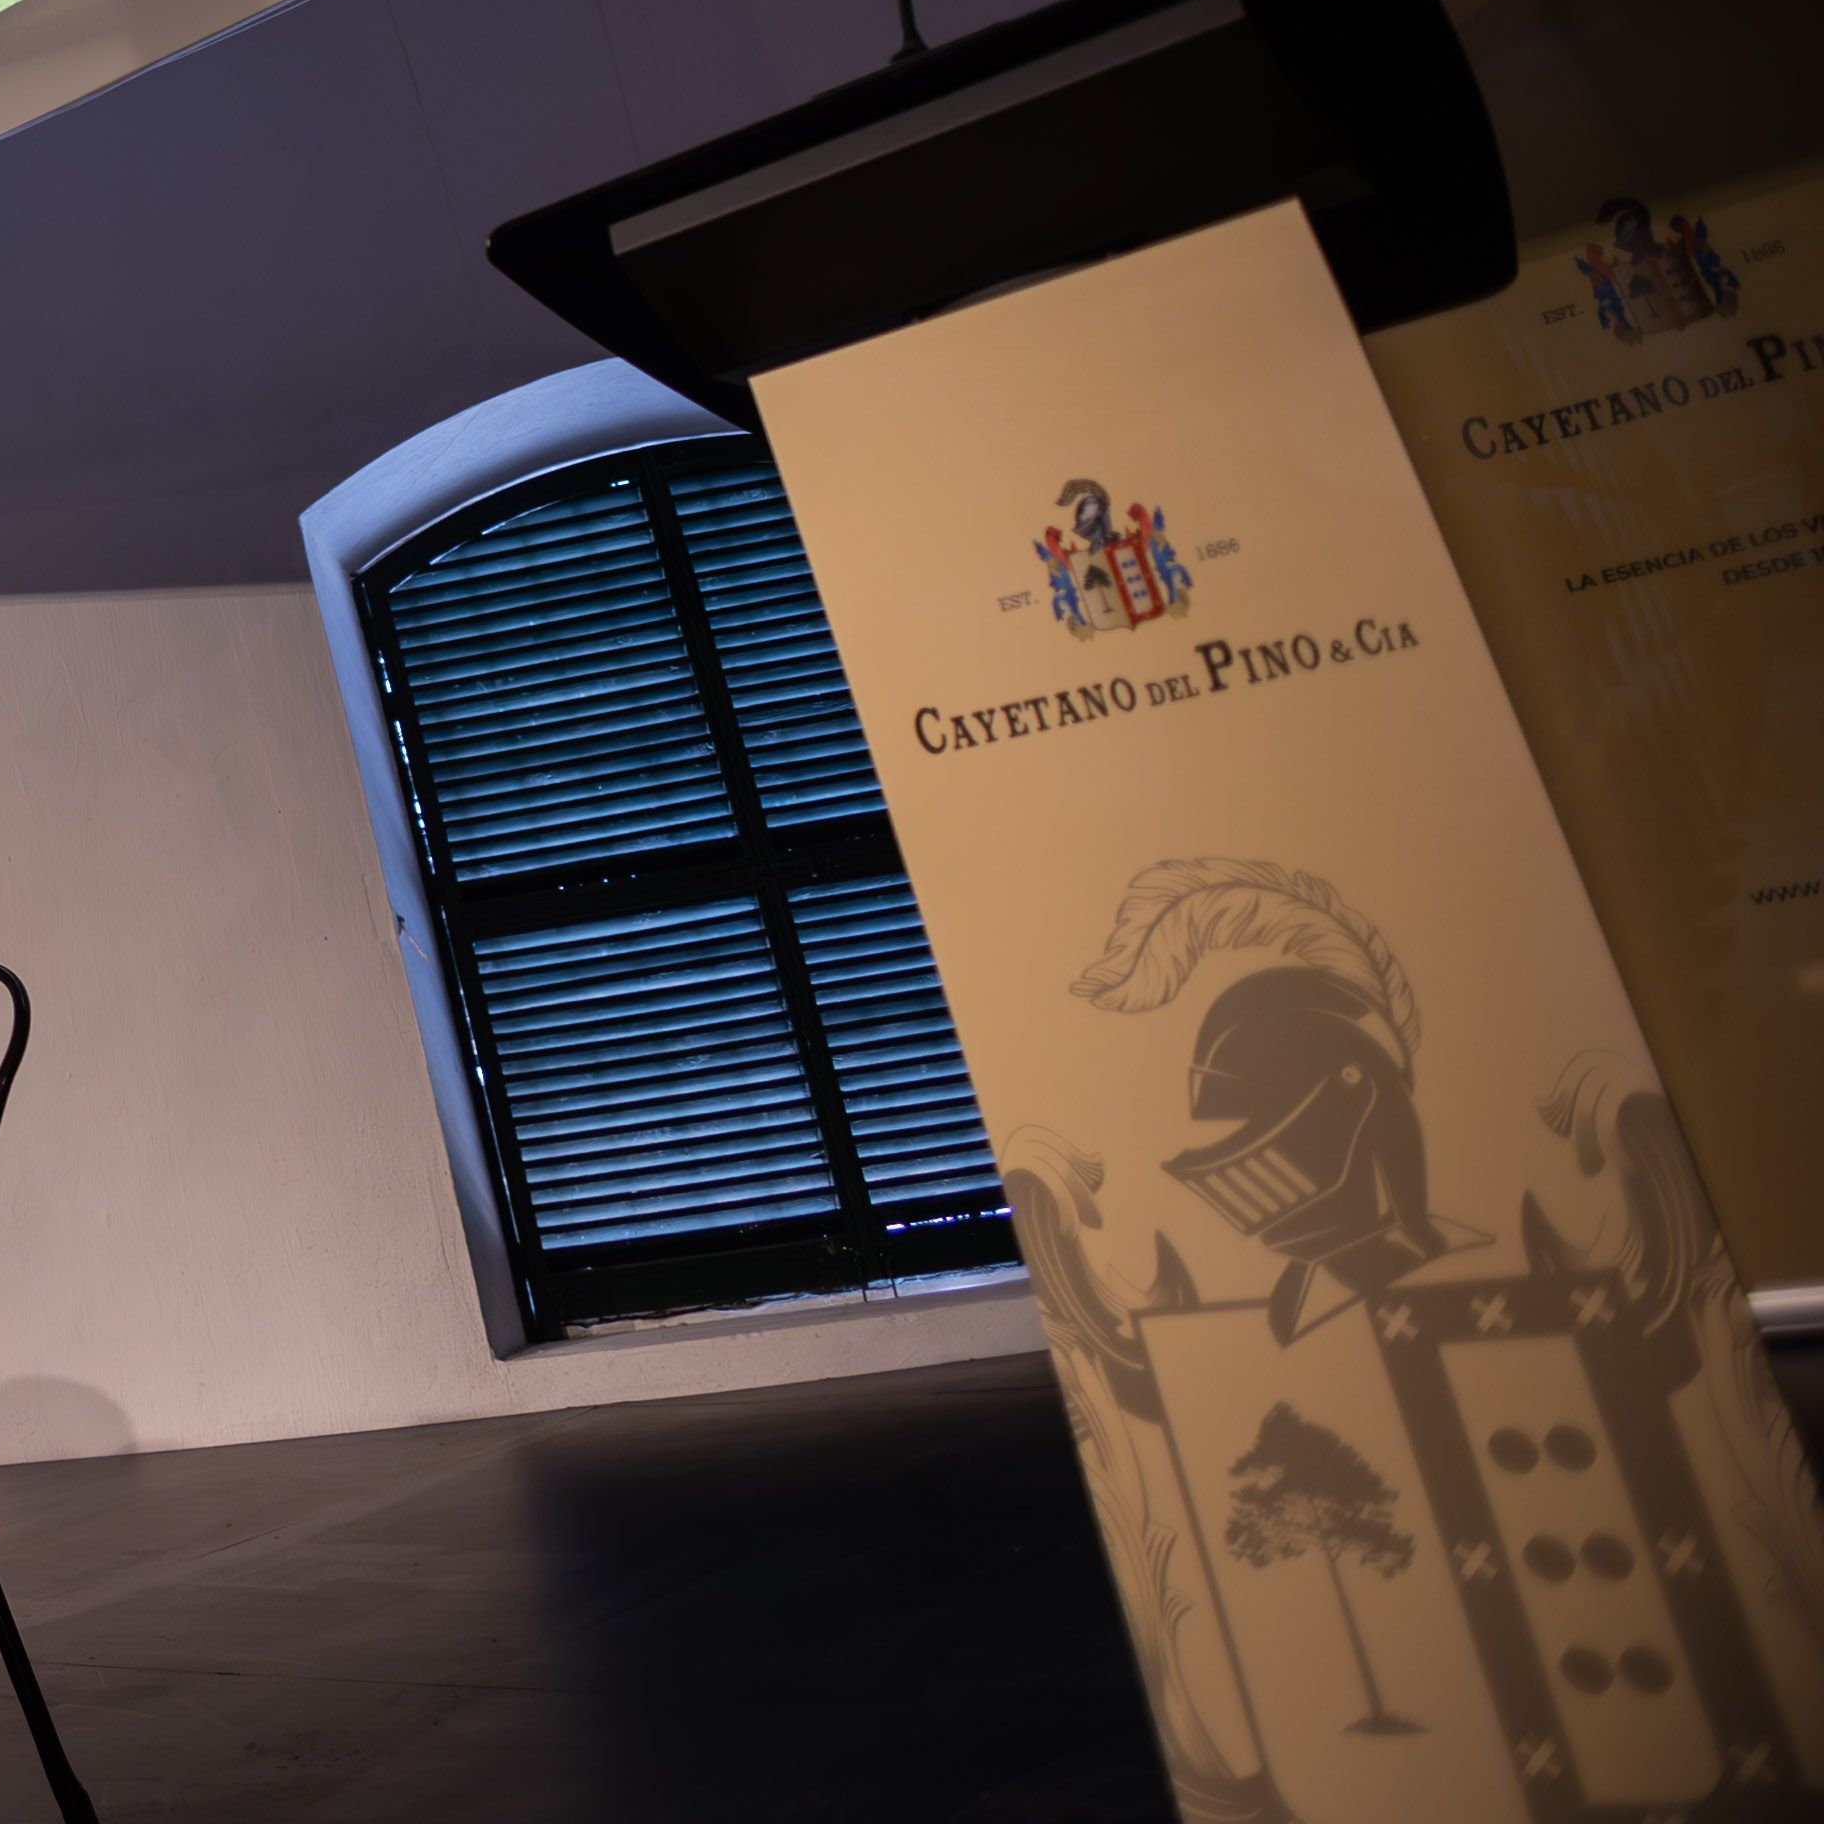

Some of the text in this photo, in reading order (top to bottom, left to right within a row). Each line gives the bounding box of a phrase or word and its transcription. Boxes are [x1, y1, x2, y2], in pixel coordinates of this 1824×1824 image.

[1542, 303, 1584, 326] EST.
[1460, 377, 1691, 461] CAYETANO
[1700, 367, 1755, 401] DEL
[1565, 573, 1598, 593] LA
[1601, 547, 1706, 584] ESENCIA
[1709, 536, 1746, 558] DE
[1749, 522, 1798, 547] LOS
[1723, 551, 1809, 585] DESDE
[997, 590, 1041, 613] EST.
[914, 677, 1138, 755] CAYETANO
[1144, 673, 1201, 707] DEL
[1193, 637, 1322, 693] PINO
[1330, 638, 1355, 664] &
